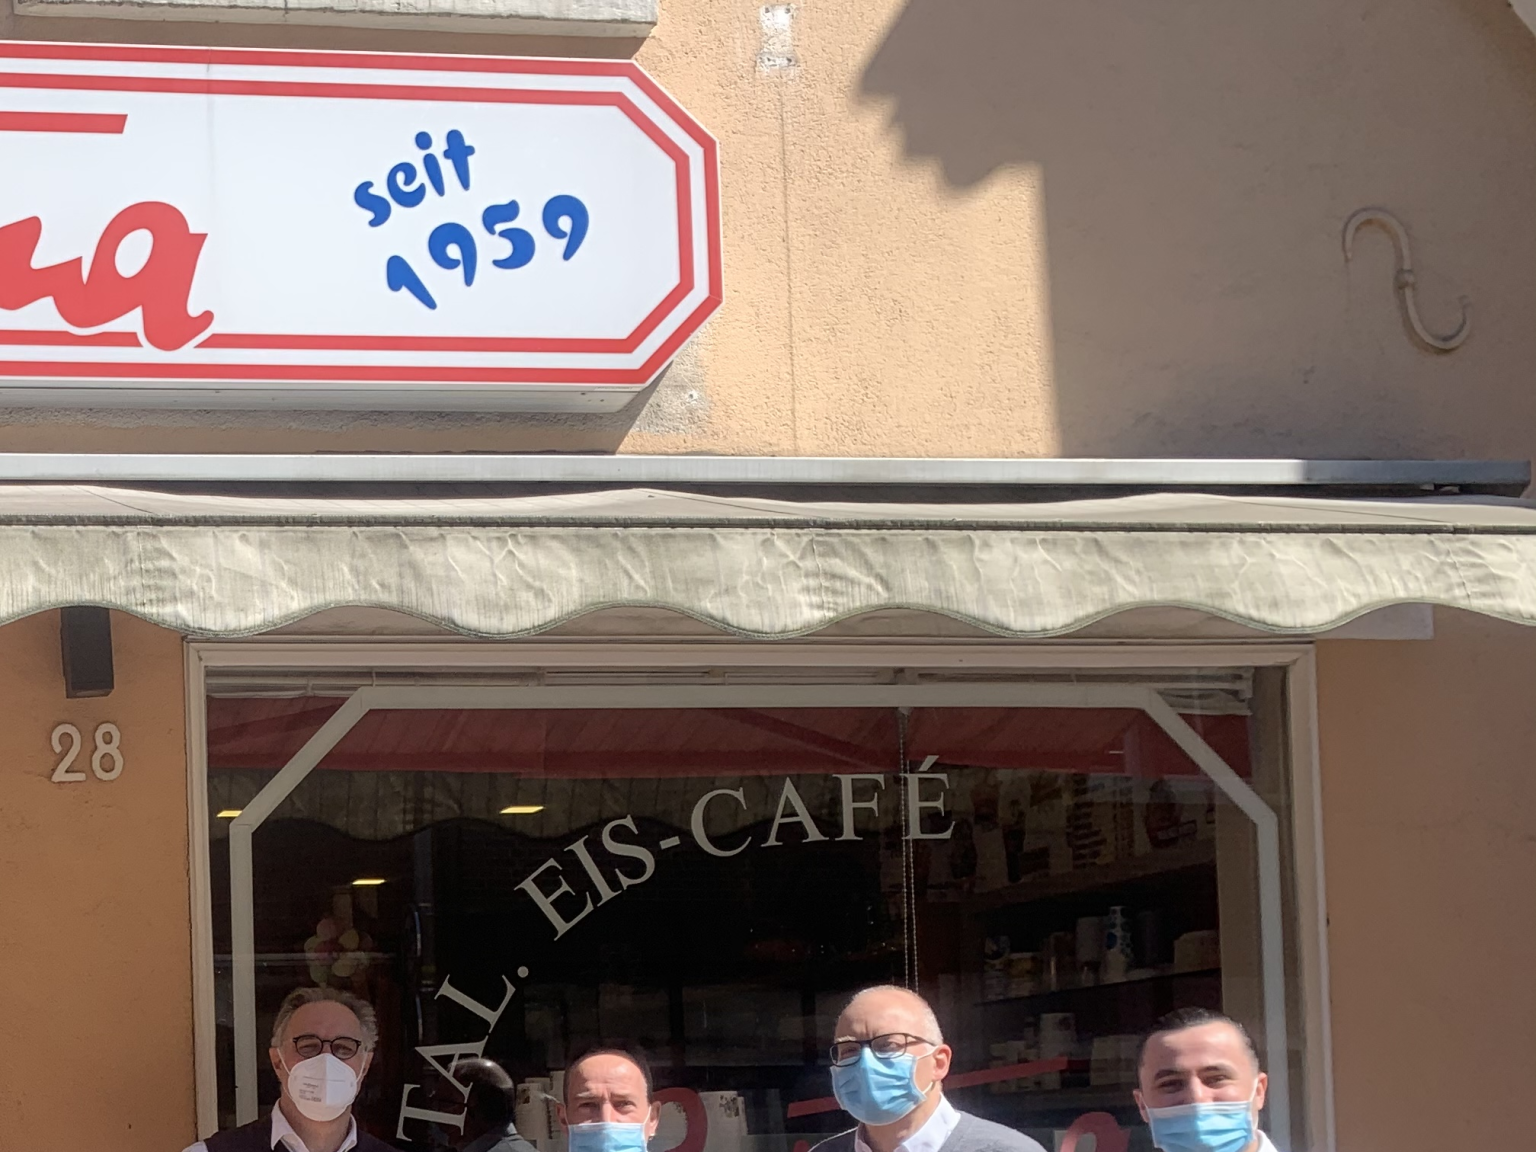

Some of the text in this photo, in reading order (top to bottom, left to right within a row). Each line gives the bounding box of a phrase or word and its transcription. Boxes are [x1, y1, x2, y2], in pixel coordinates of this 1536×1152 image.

[354, 129, 475, 227] seit
[386, 194, 589, 310] 1959
[51, 722, 124, 783] 28
[514, 755, 956, 941] EIS-CAFÉ
